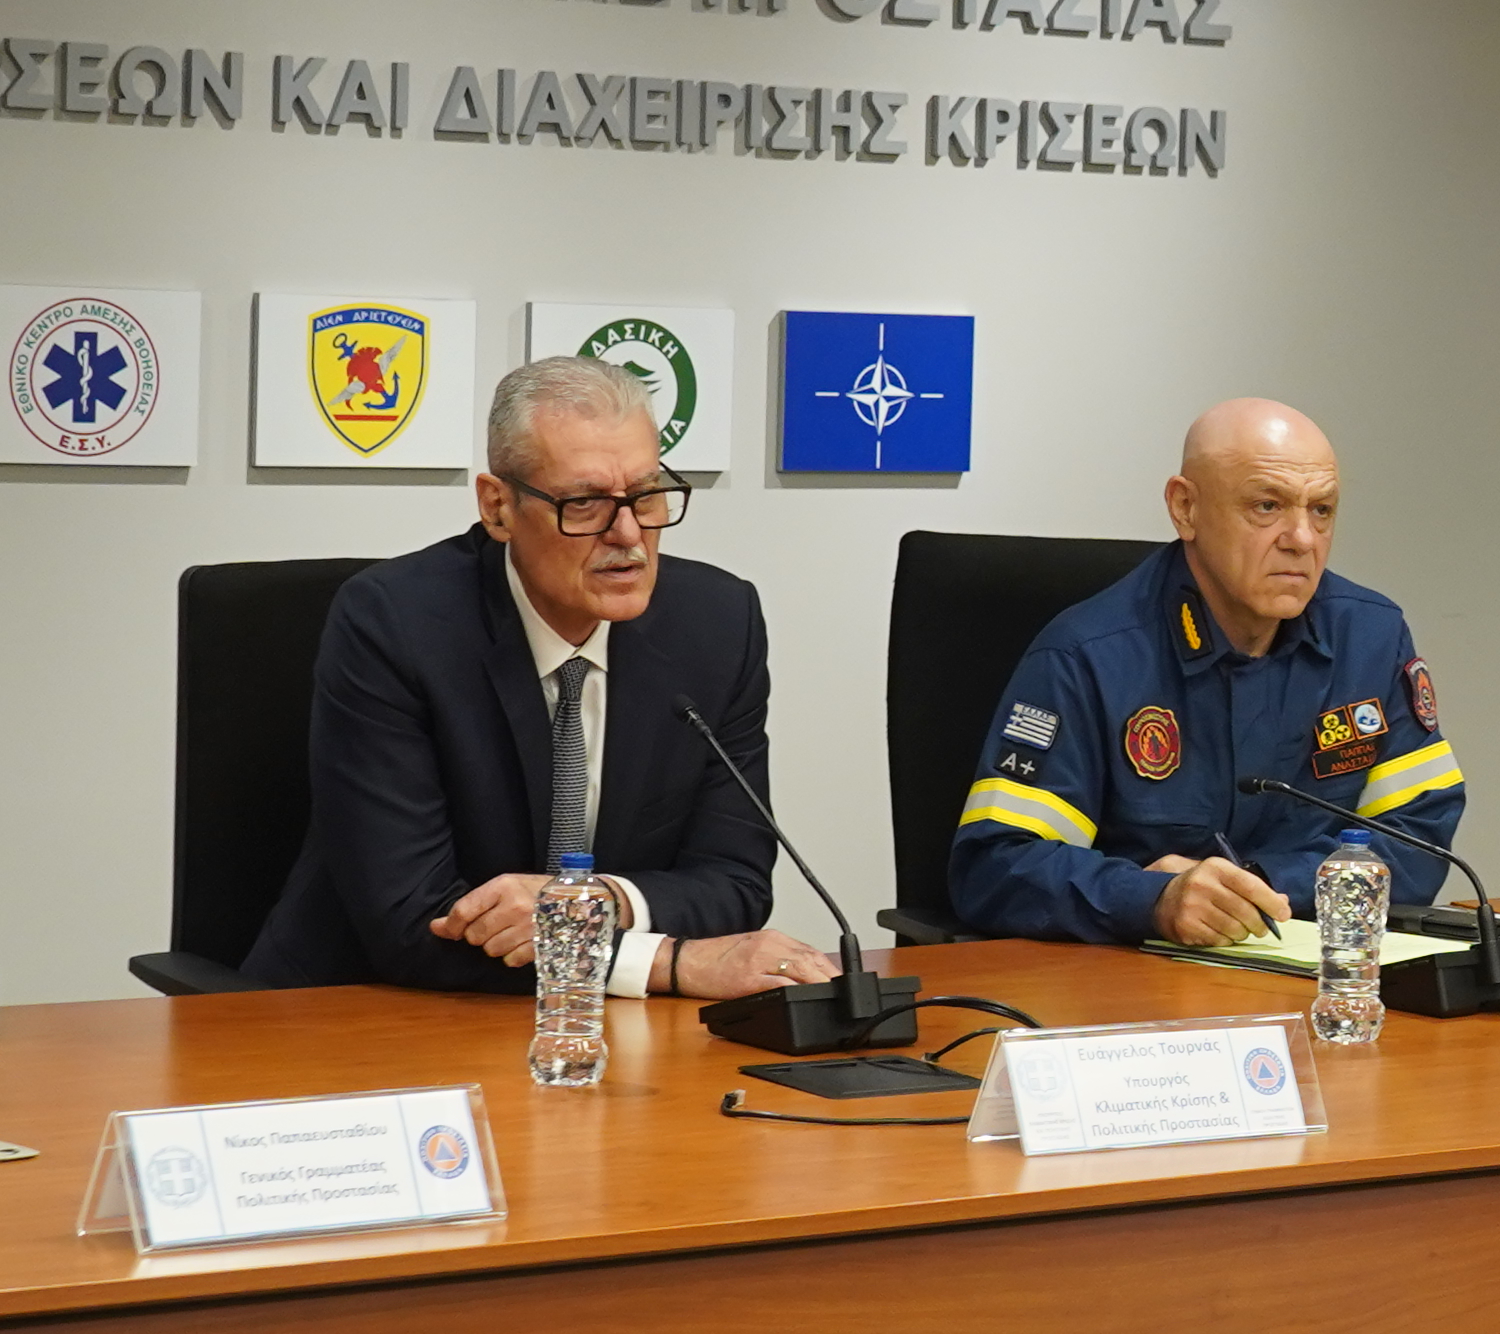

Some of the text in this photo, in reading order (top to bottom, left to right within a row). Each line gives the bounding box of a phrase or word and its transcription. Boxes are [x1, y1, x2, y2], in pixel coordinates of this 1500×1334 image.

[271, 54, 409, 138] ΚΑΙ
[434, 66, 909, 163] ΔΙΑΧΕΙΡΙΣΗΣ
[925, 94, 1227, 178] ΚΡΙΣΕΩΝ
[591, 323, 679, 359] ΔΑΣΙΚΗ
[15, 304, 154, 417] ΕΘΝΙΚΟ ΚΕΝΤΡΟ ΑΜΕΣΗΣ ΒΟΗΘΕΙΑΣ
[58, 435, 112, 452] Ε.Σ.Υ.
[1078, 1039, 1221, 1062] Ευάγγελος Τουρνάς
[1123, 1072, 1190, 1089] Υπουργός
[1095, 1092, 1230, 1115] Κλιματικής Κρίσης &
[1092, 1119, 1158, 1138] Πολιτικής
[1159, 1114, 1239, 1131] Προστασίας
